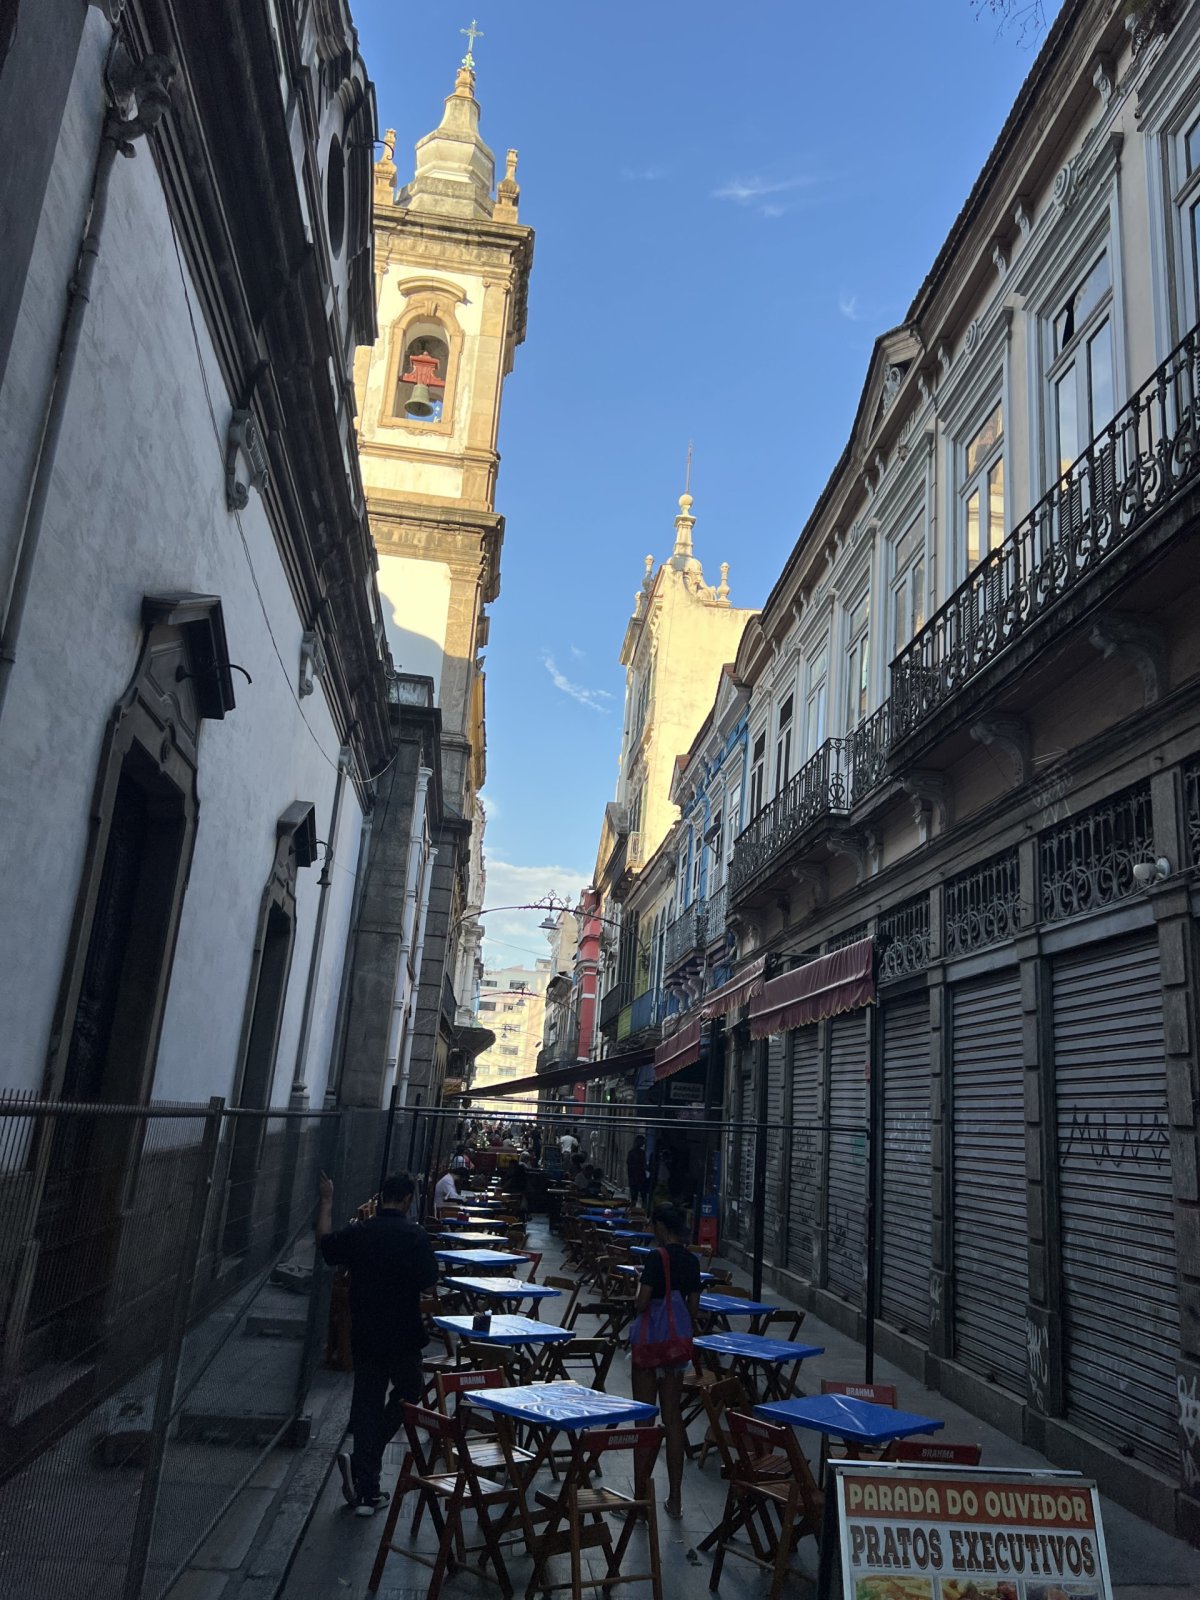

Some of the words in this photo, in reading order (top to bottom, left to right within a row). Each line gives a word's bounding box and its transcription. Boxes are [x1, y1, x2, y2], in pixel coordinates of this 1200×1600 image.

[460, 1375, 486, 1386] BRAHMA
[845, 1387, 875, 1398] BRAHMA
[608, 1434, 639, 1446] BRAHMA
[922, 1448, 954, 1460] BRAHMA
[849, 1484, 940, 1514] PARADA
[946, 1489, 979, 1517] DO
[985, 1491, 1088, 1522] OUVIDOR
[850, 1525, 944, 1570] PRATOS
[950, 1530, 1097, 1577] EXECUTIVOS
